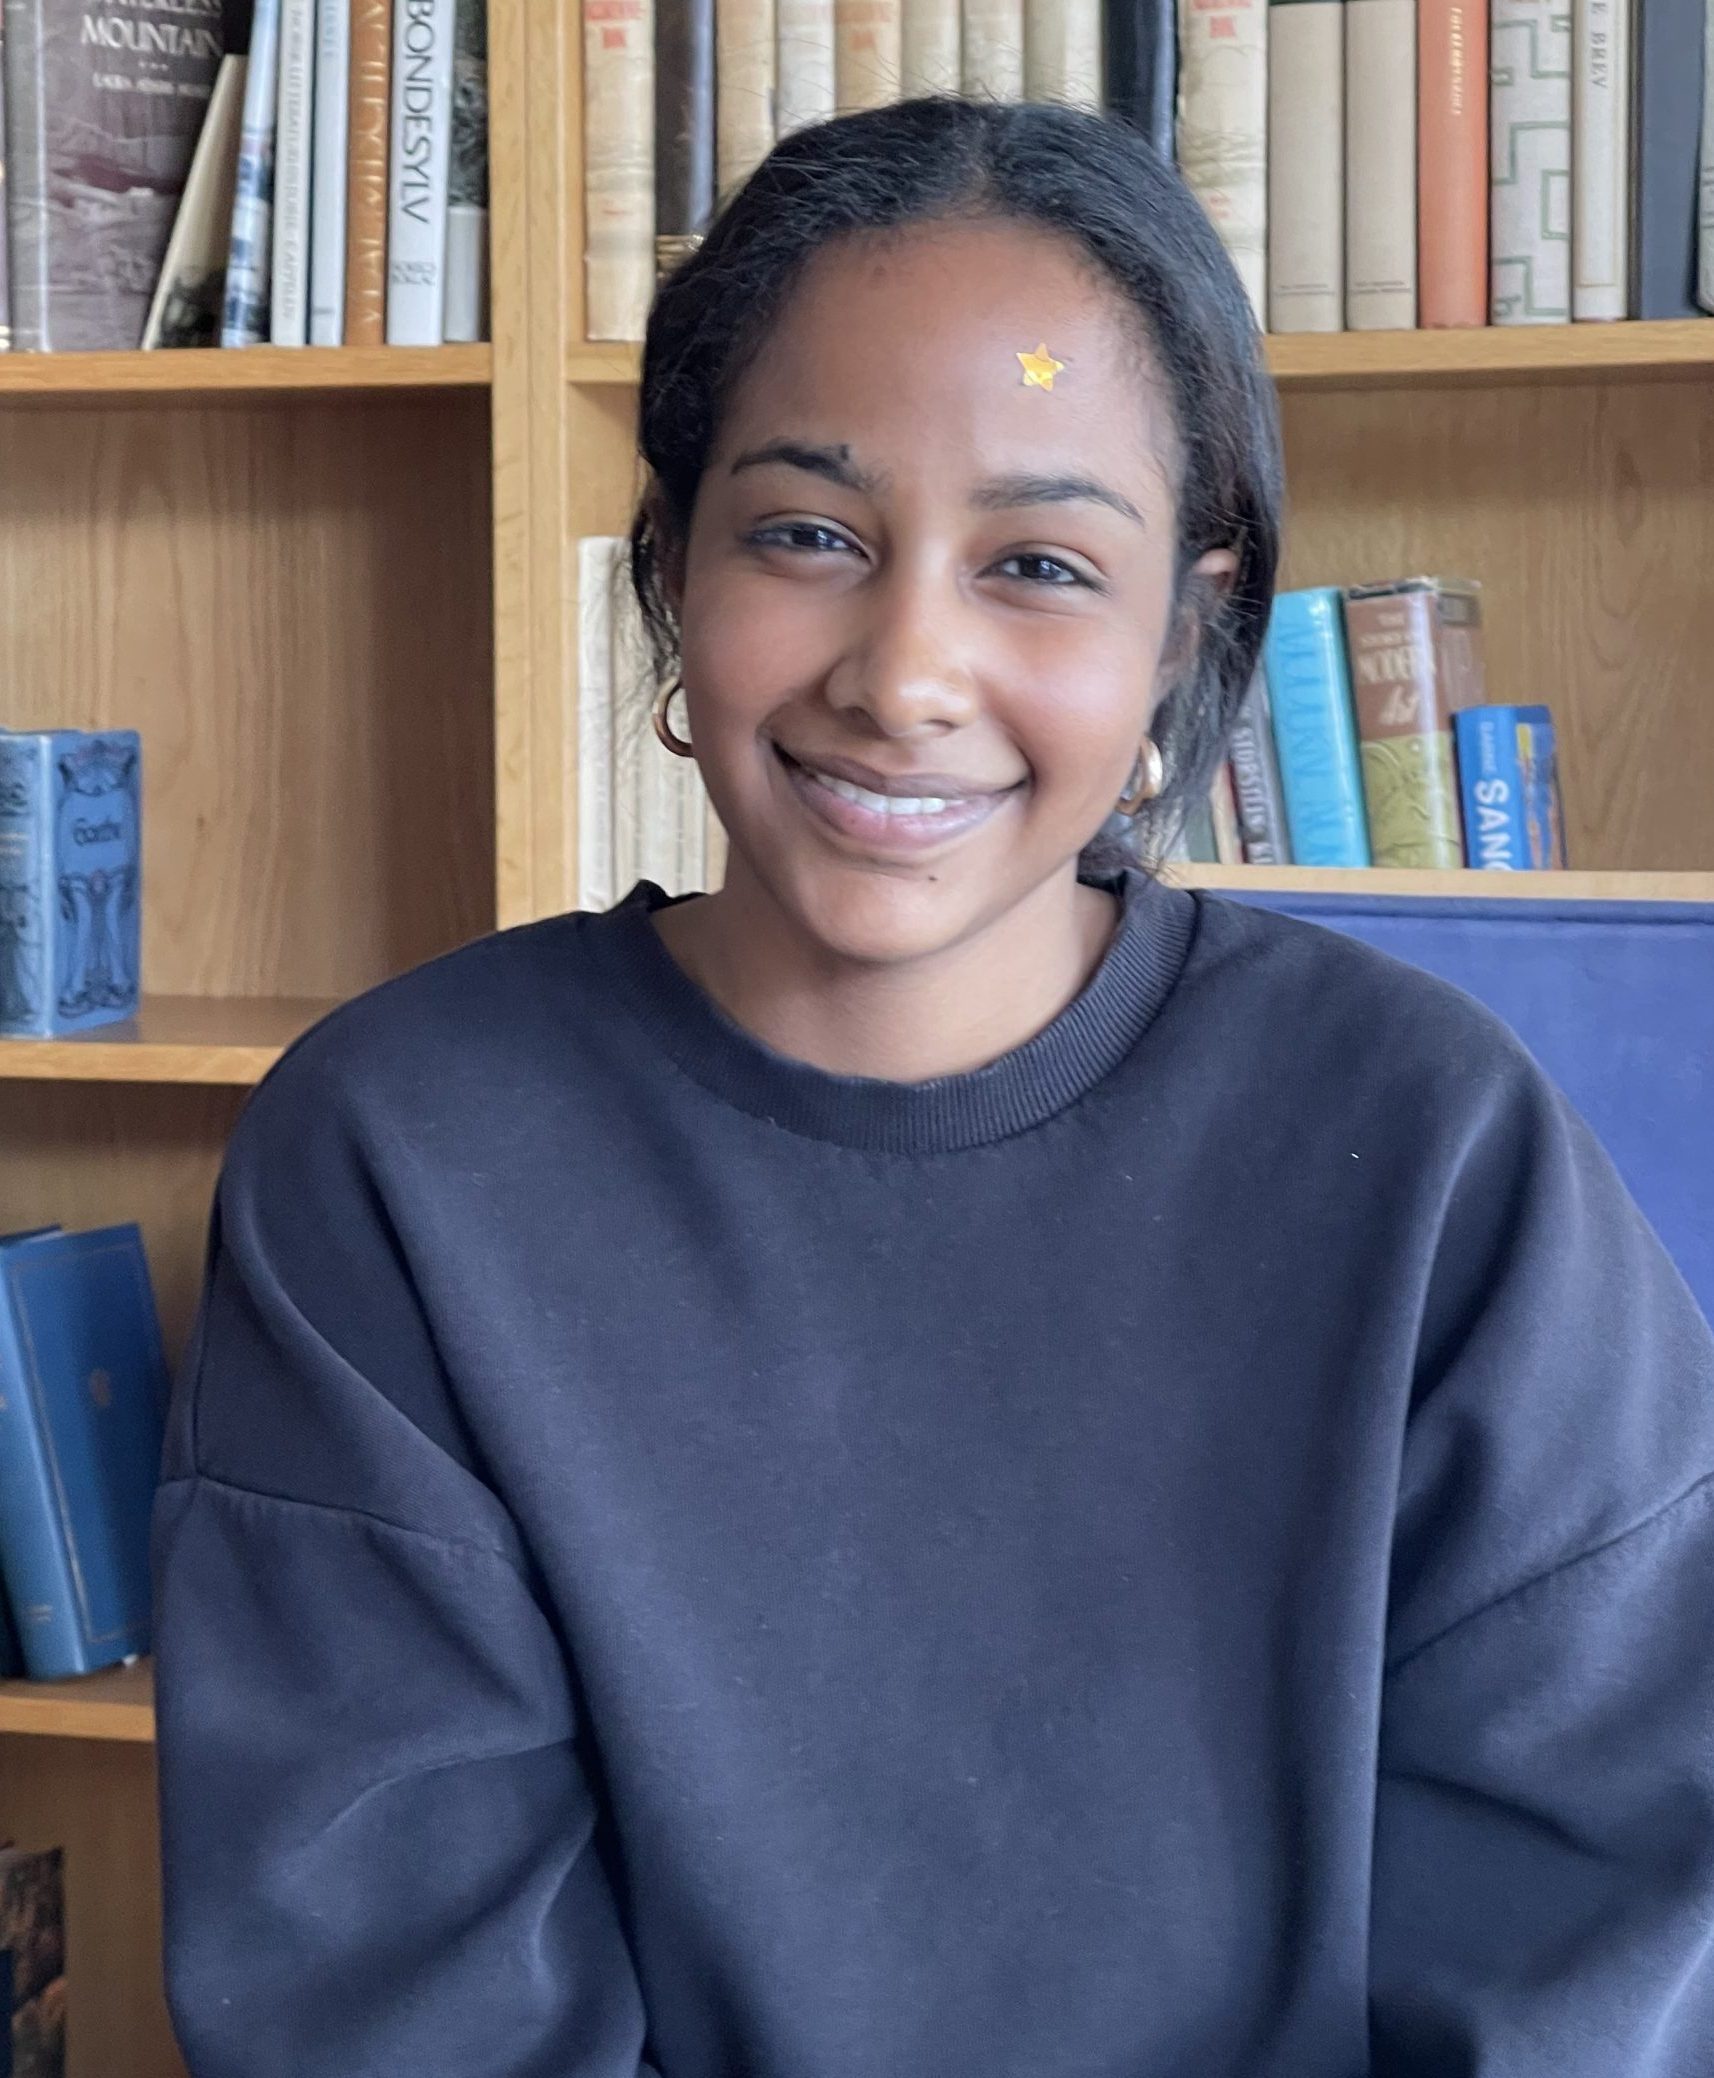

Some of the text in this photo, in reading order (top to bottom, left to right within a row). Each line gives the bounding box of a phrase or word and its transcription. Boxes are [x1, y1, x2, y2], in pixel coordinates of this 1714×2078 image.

[79, 14, 224, 58] MOUNTAIN
[1592, 31, 1608, 89] BREV
[401, 0, 436, 225] BONDESYLV
